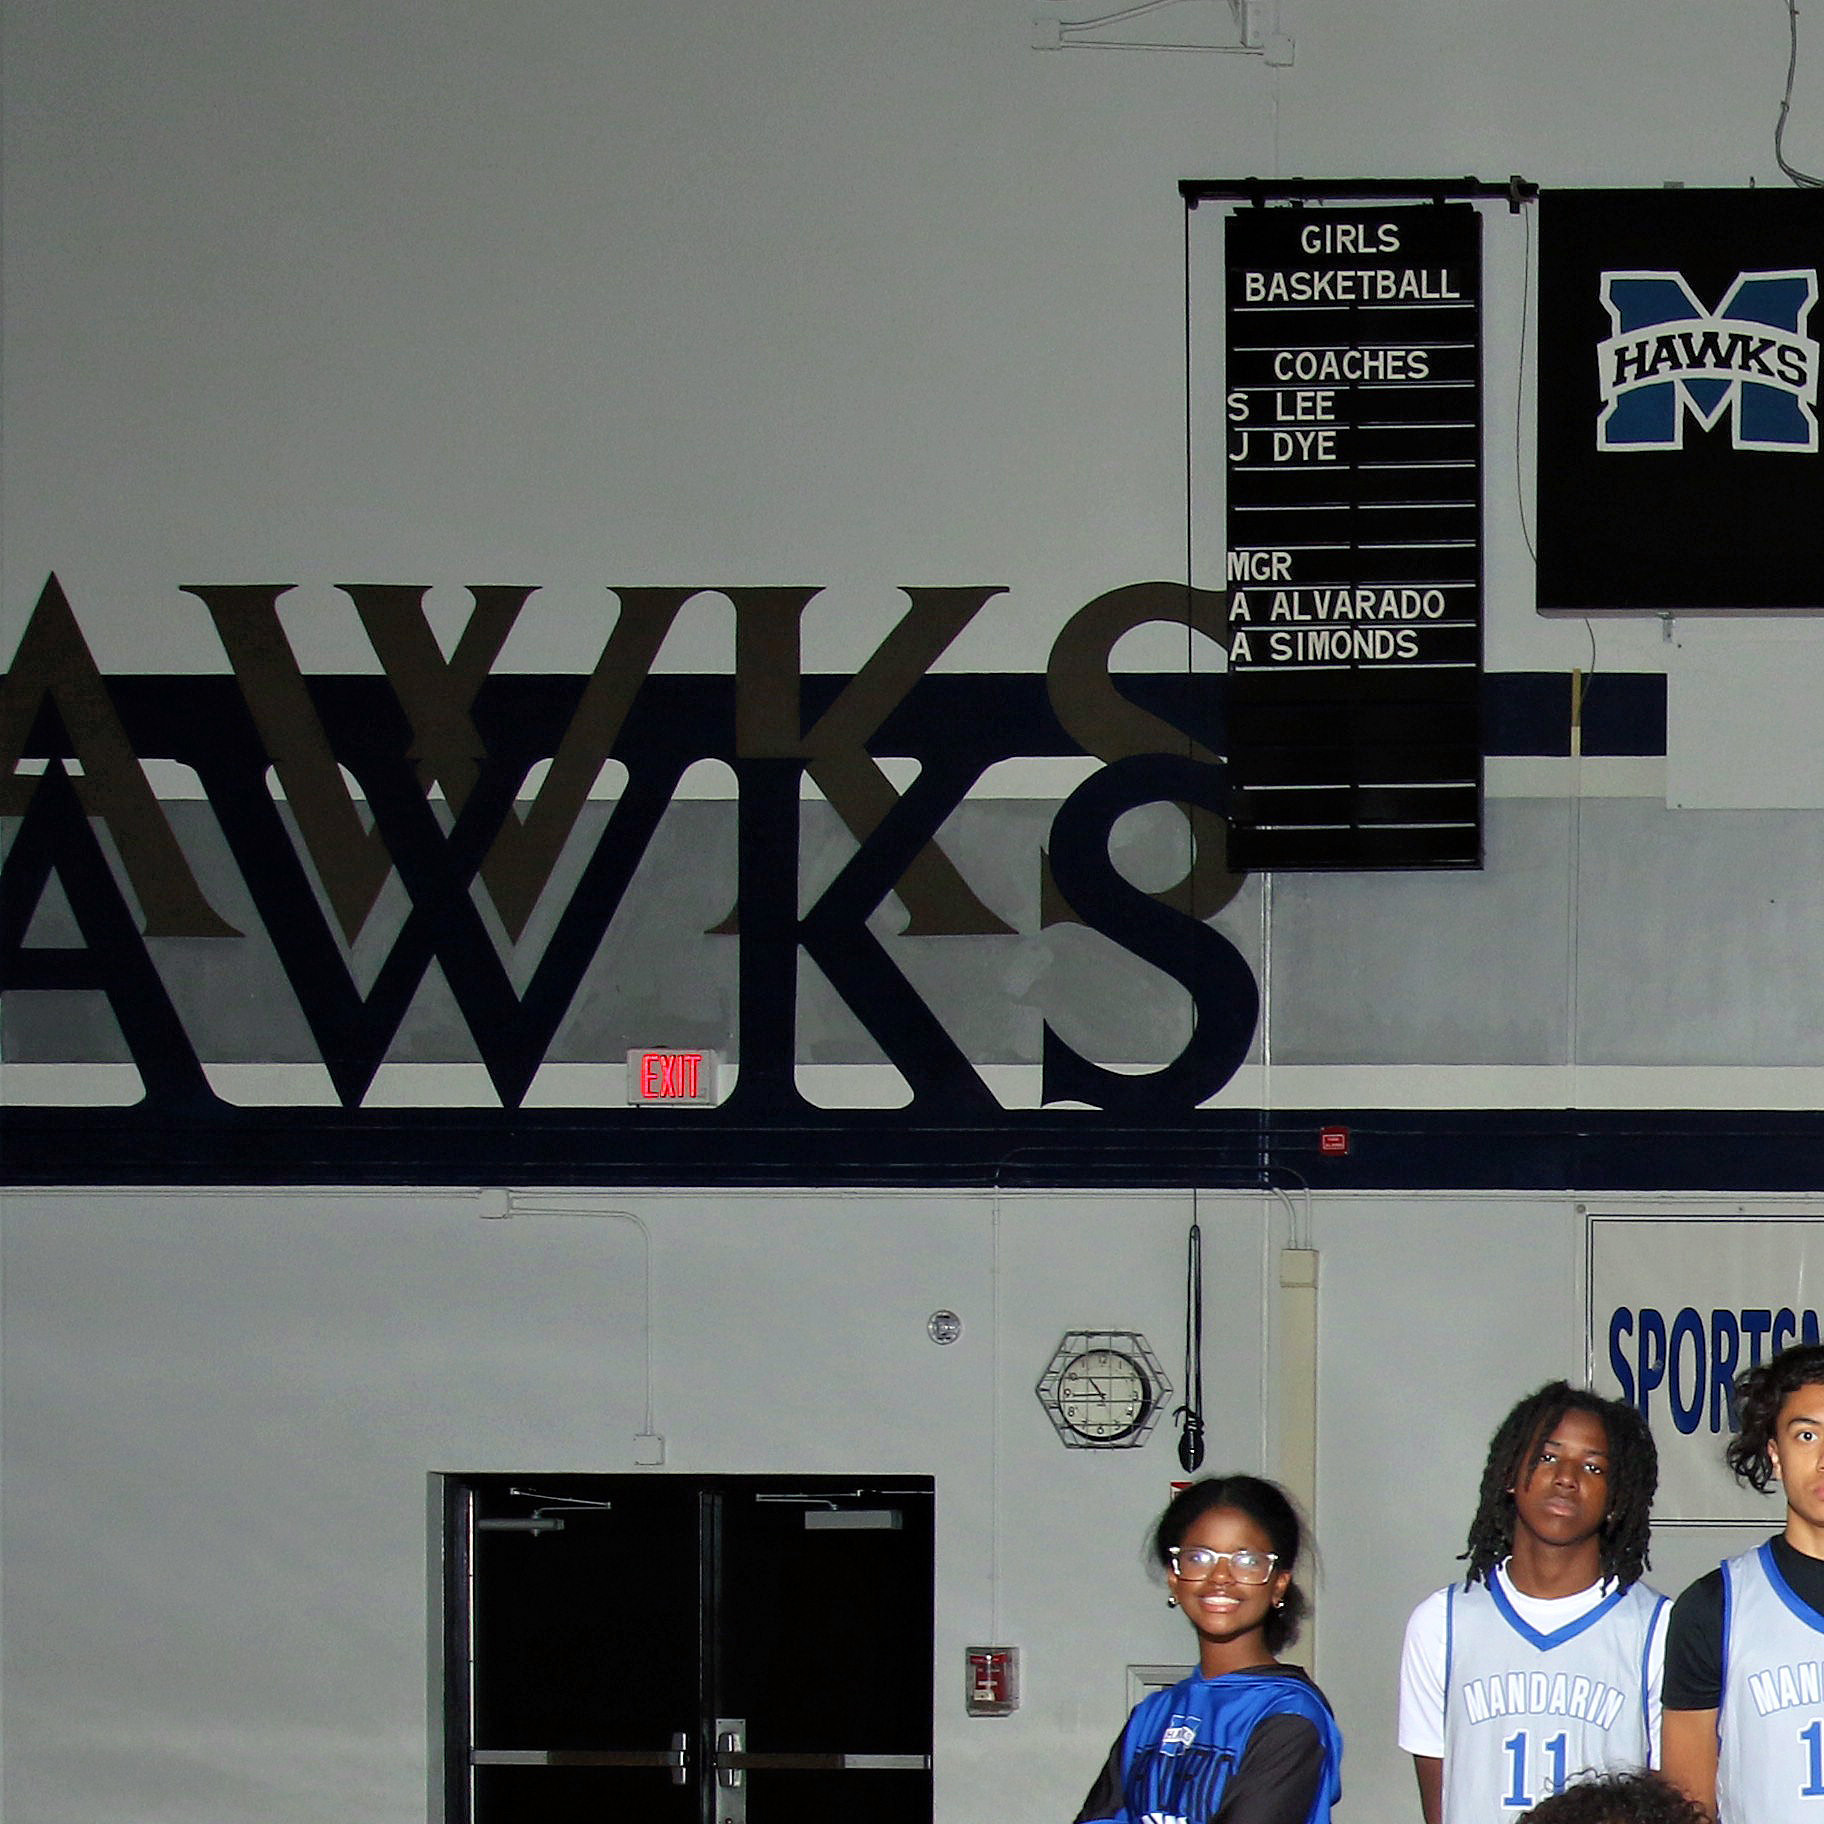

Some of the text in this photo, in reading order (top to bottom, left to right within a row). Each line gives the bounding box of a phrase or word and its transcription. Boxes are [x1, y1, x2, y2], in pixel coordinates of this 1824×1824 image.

[1300, 224, 1400, 255] GIRLS
[1245, 270, 1460, 303] BASKETBALL
[1274, 350, 1429, 381] COACHES
[1612, 331, 1808, 389] HAWKS
[1228, 391, 1335, 421] S LEE
[1229, 431, 1337, 461] J DYE
[1227, 552, 1292, 582] MGR
[1230, 590, 1446, 622] A ALVARADO
[1230, 630, 1419, 662] A SIMONDS
[641, 1054, 703, 1098] EXIT
[1463, 1671, 1625, 1731] MANDARIN
[1502, 1729, 1571, 1809] 11
